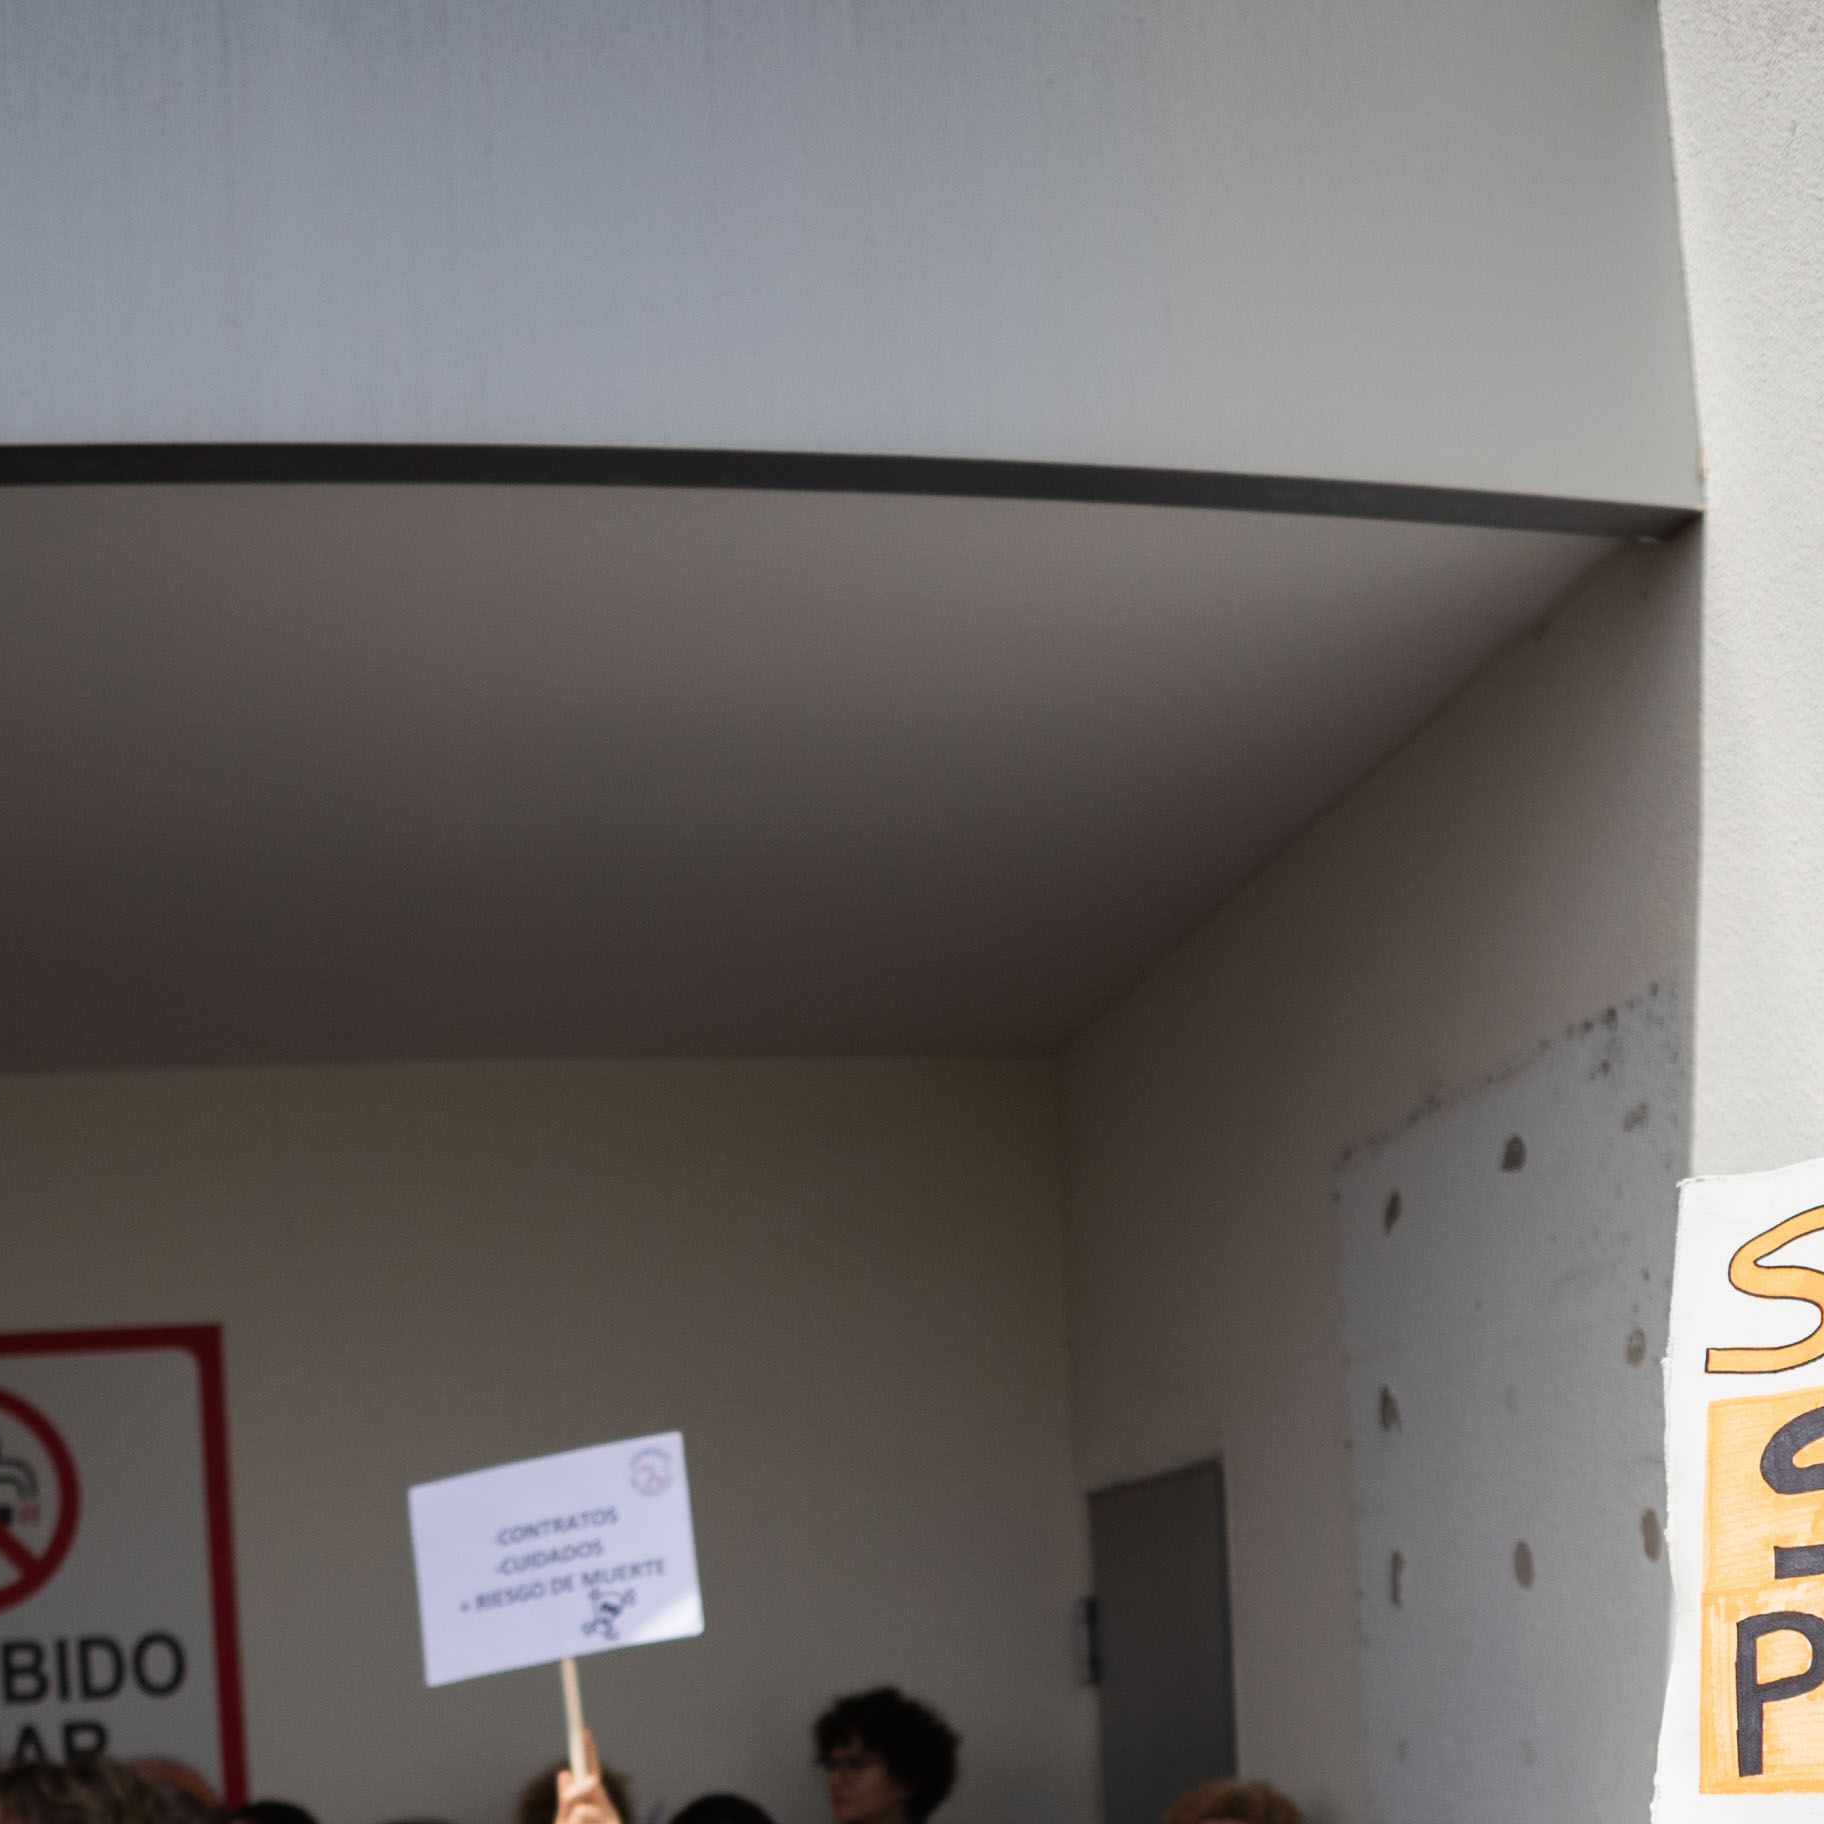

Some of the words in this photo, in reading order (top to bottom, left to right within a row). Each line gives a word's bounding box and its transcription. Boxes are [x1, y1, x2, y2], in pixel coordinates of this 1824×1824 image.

[475, 1581, 546, 1611] RIESGO
[550, 1573, 576, 1596] DE
[581, 1557, 666, 1586] MUERTE
